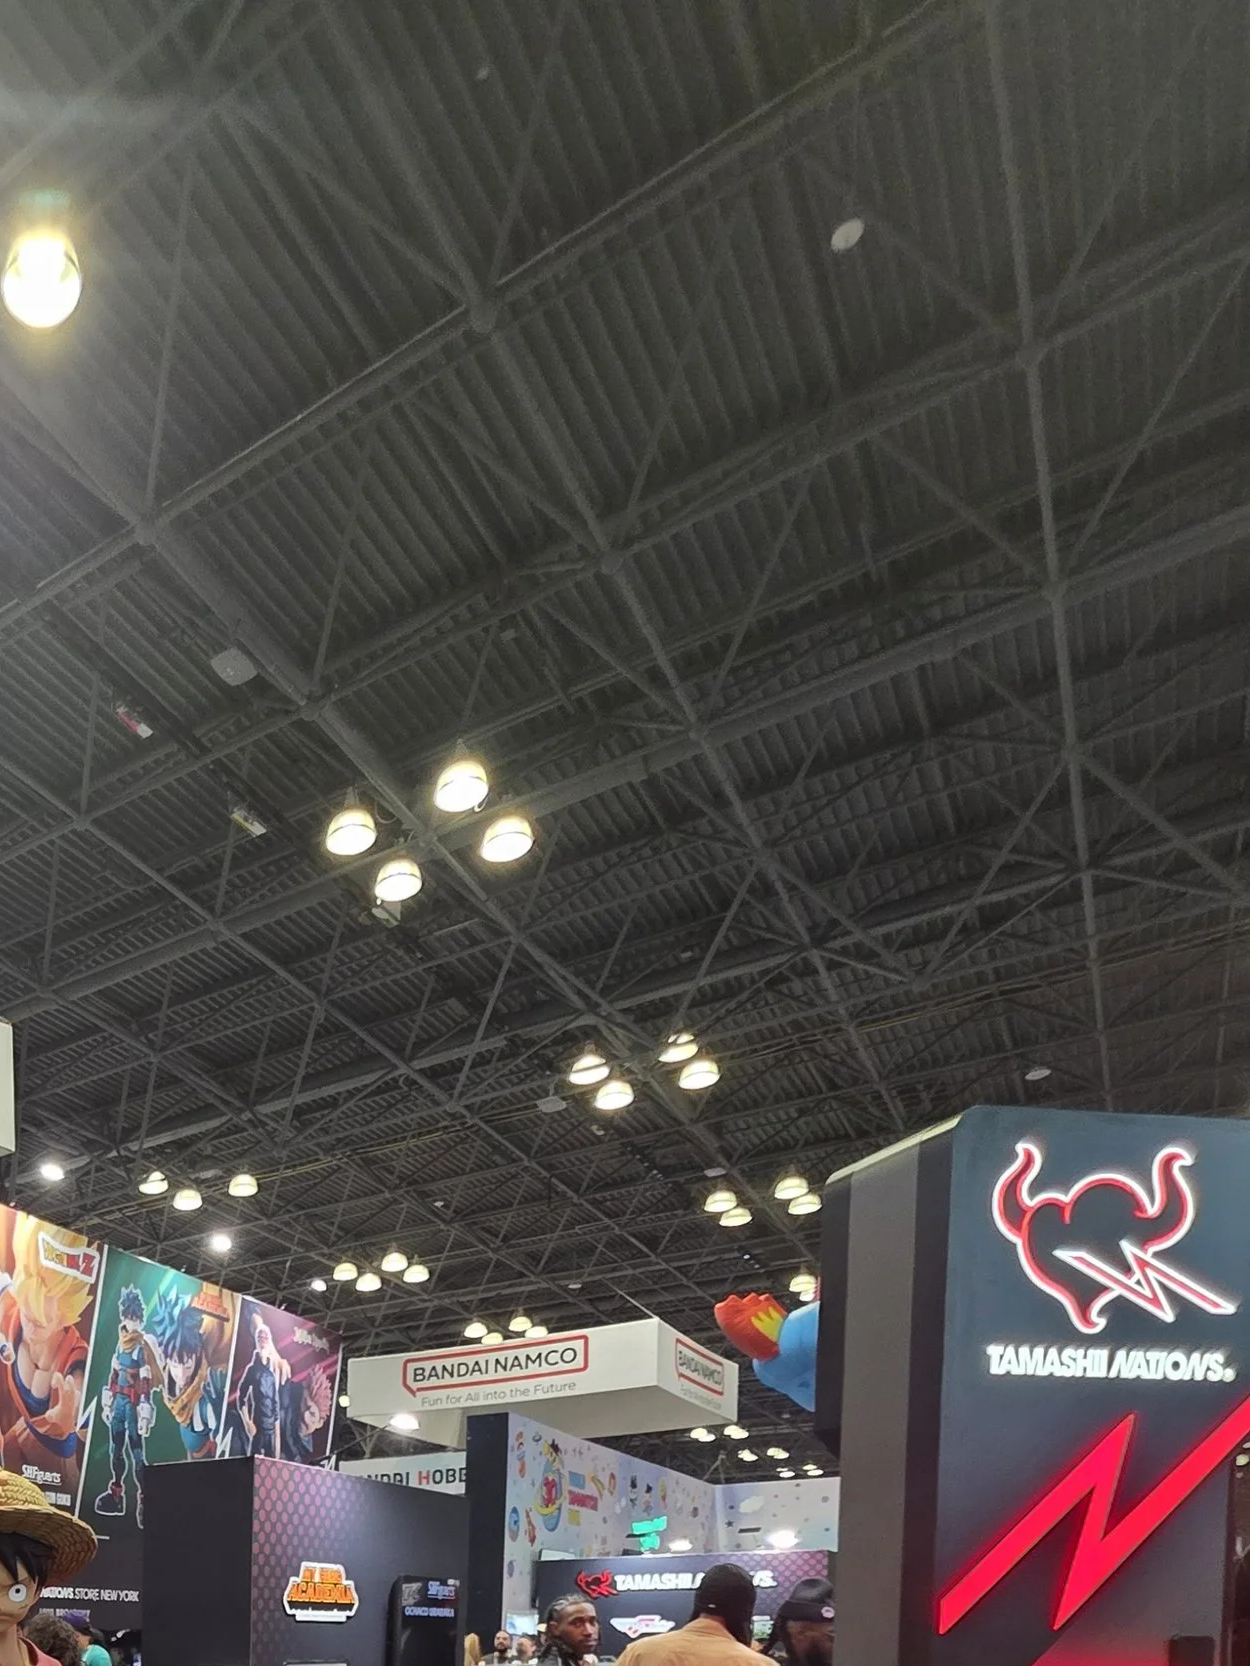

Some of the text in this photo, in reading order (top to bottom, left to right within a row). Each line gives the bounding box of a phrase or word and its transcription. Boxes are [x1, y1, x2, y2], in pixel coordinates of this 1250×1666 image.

[413, 1347, 578, 1383] BANDAI NAMCO
[987, 1345, 1109, 1378] TAMASHII
[421, 1382, 577, 1408] Fun for All into the Future
[101, 1589, 118, 1602] NEW
[117, 1590, 140, 1602] YORK
